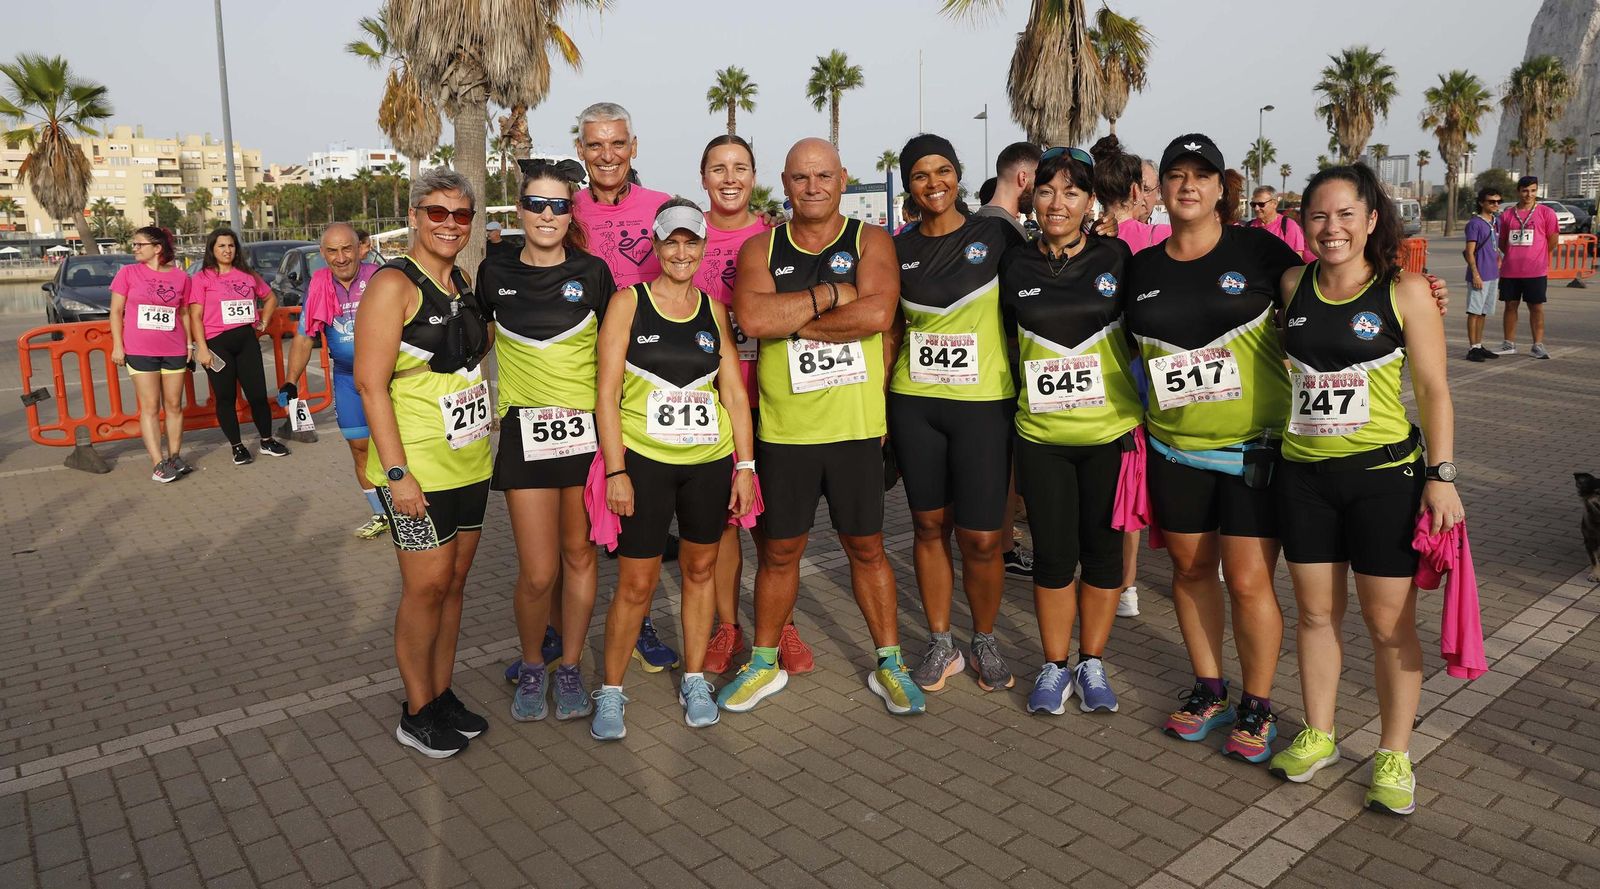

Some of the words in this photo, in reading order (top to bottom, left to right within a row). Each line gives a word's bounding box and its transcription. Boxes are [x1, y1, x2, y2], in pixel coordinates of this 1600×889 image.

[1512, 233, 1529, 241] 91
[143, 312, 170, 323] 148
[227, 306, 252, 316] 351
[428, 315, 443, 325] EV
[925, 339, 939, 347] POR
[951, 339, 975, 347] MUJER
[799, 345, 855, 374] 854
[919, 346, 968, 368] 842
[1043, 364, 1060, 373] POR
[1062, 363, 1071, 371] LA
[1073, 360, 1098, 370] MUJER
[1037, 369, 1093, 396] 645
[1166, 360, 1225, 393] 517
[1302, 380, 1316, 389] POR
[1318, 379, 1330, 389] LA
[1332, 378, 1365, 388] MUJER
[1299, 389, 1356, 415] 247
[452, 397, 487, 431] 275
[538, 413, 554, 421] POR
[555, 411, 565, 419] LA
[657, 404, 710, 427] 813
[532, 416, 585, 443] 583
